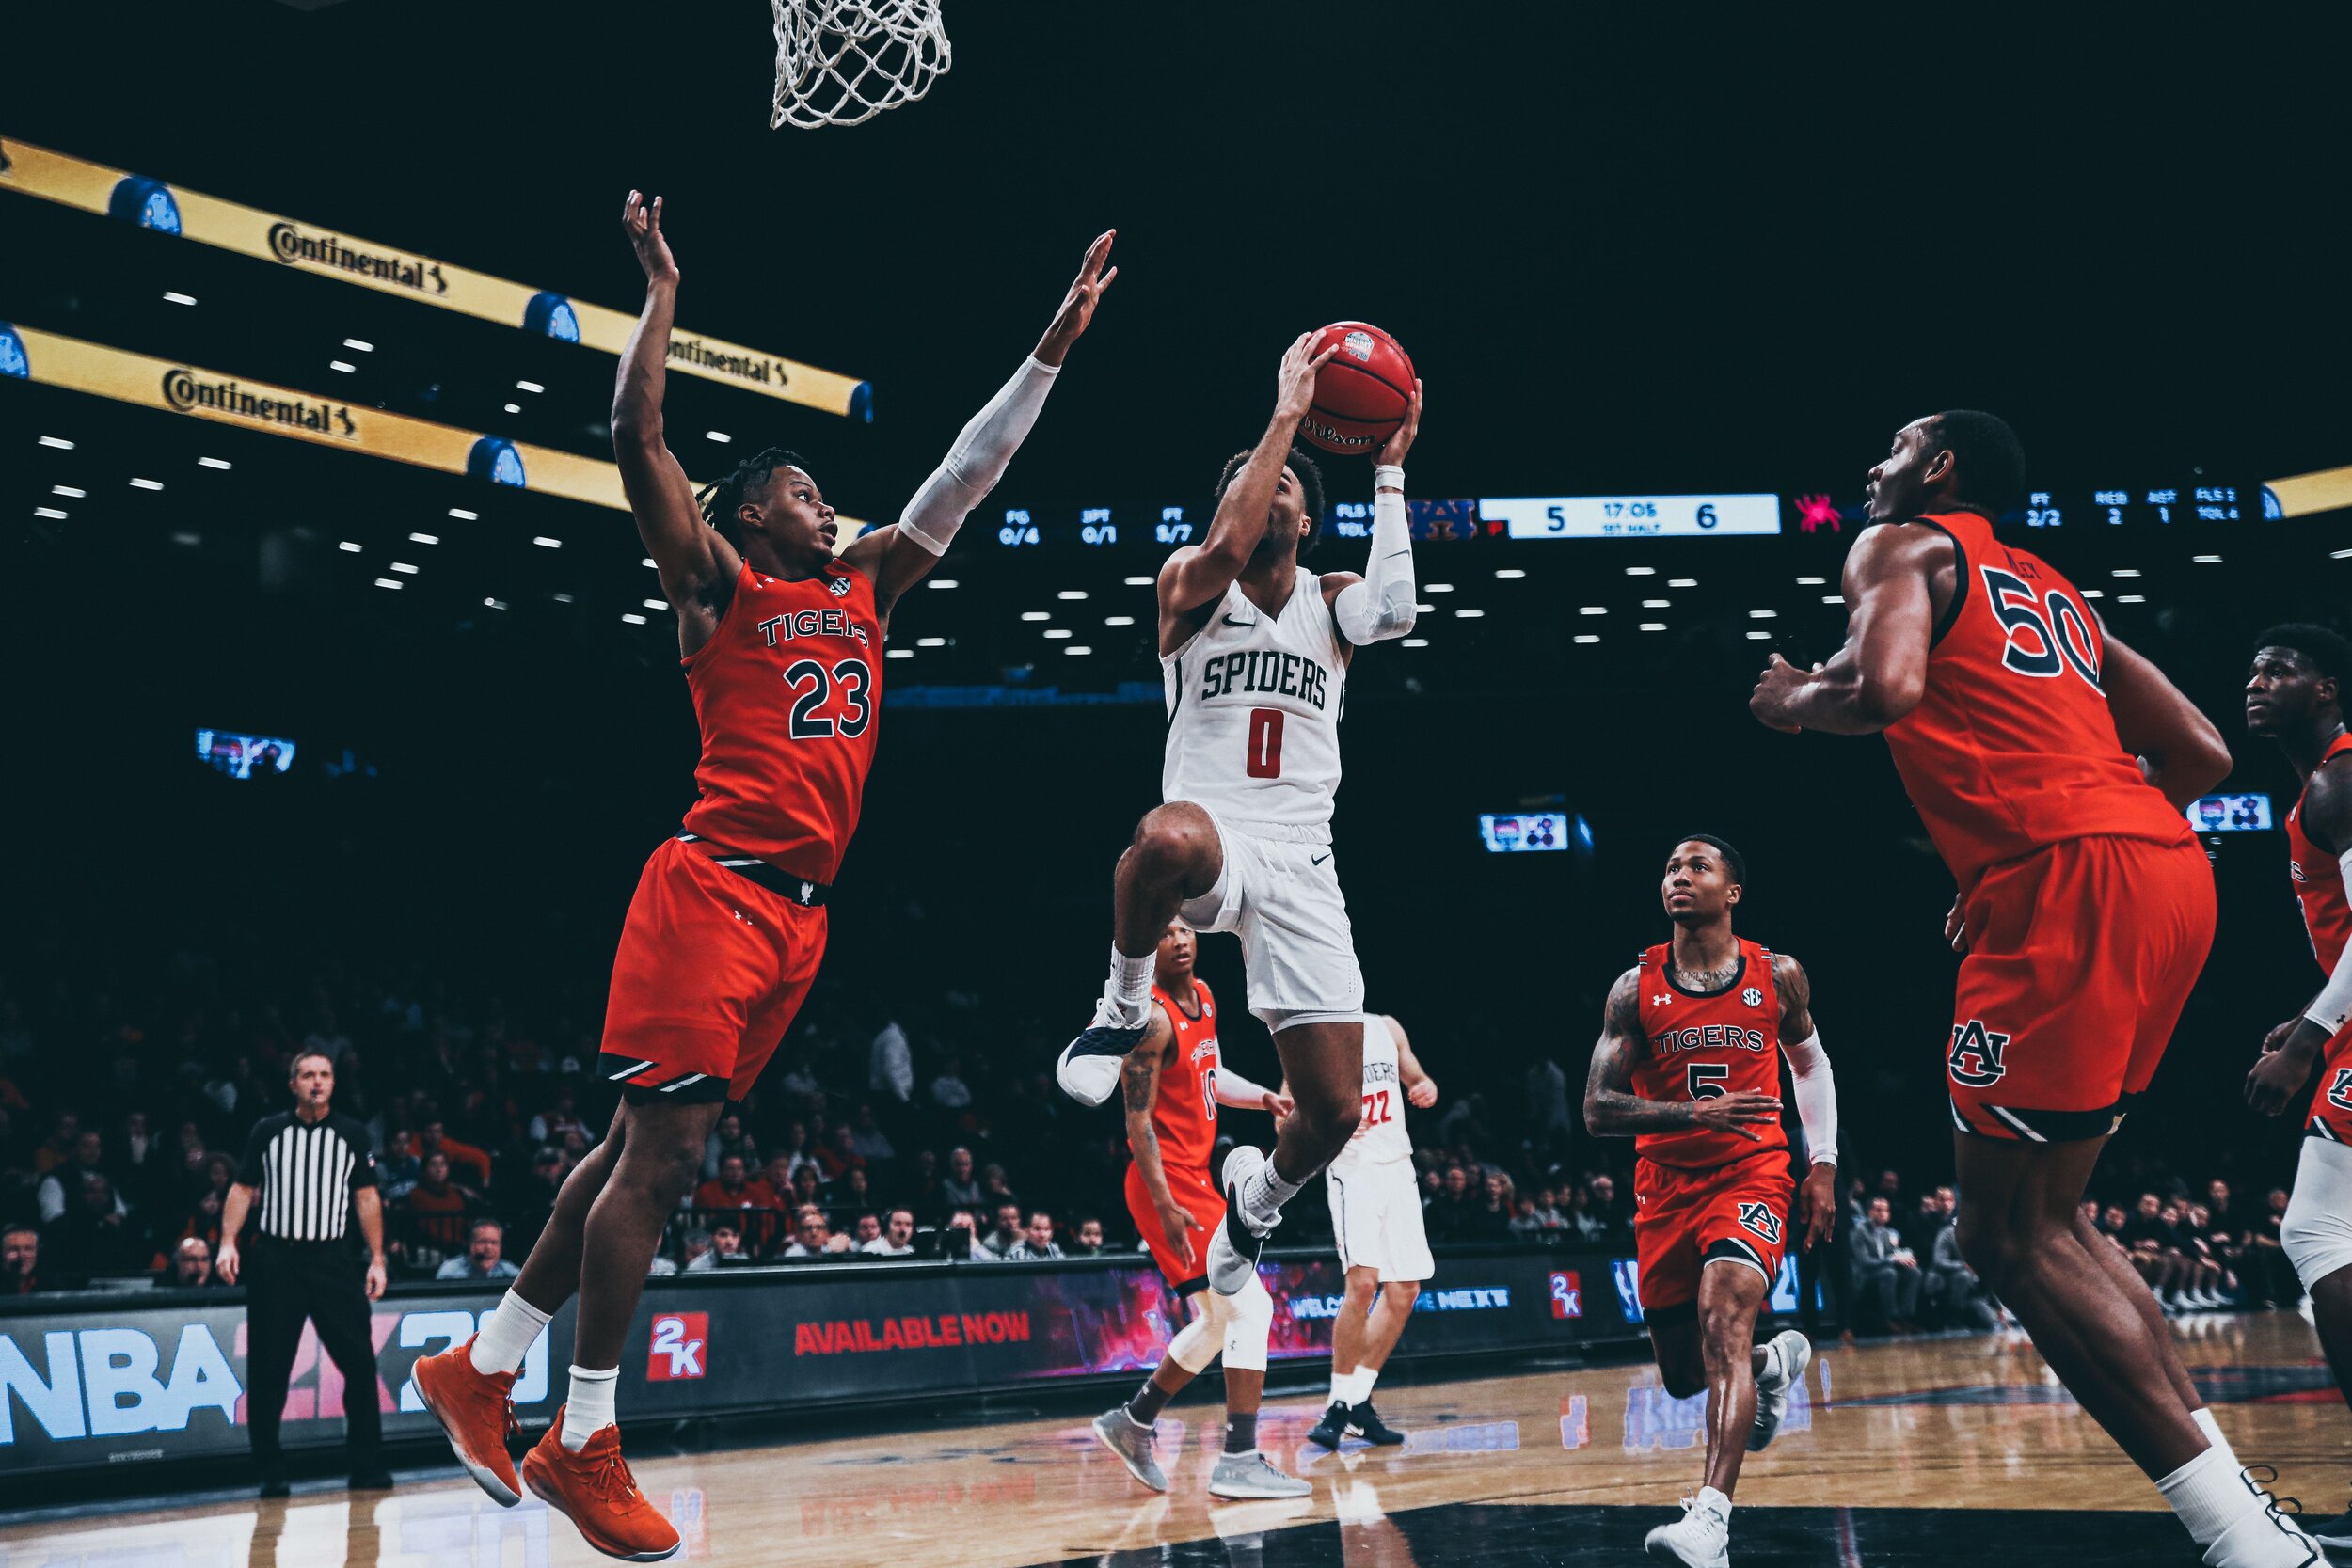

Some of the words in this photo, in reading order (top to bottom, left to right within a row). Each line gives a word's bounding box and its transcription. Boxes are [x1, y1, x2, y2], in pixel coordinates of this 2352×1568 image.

[267, 222, 423, 288] Continental
[667, 340, 770, 383] ntinental
[163, 369, 330, 431] Continental
[1300, 415, 1376, 447] Wilson
[1547, 505, 1565, 531] 5
[1696, 504, 1717, 529] 6
[2108, 508, 2123, 525] 2
[2157, 506, 2169, 523] 1
[999, 527, 1040, 546] 0/4
[1082, 526, 1117, 545] 0/1
[828, 576, 851, 597] SEC
[1979, 564, 2106, 698] 50
[783, 658, 872, 740] 23
[1201, 650, 1327, 711] SPIDERS
[1247, 708, 1284, 779] 0
[1742, 987, 1763, 1007] SEC
[1655, 1024, 1764, 1053] TIGERS
[1364, 1062, 1397, 1084] DERS
[1687, 1063, 1729, 1102] 5
[1361, 1089, 1392, 1126] 22
[1291, 1296, 1345, 1319] WELC
[1550, 1272, 1581, 1316] 2K
[652, 1316, 703, 1378] 2K
[795, 1314, 961, 1356] AVAILABLE
[962, 1310, 1031, 1344] NOW
[0, 1323, 245, 1445] NBA
